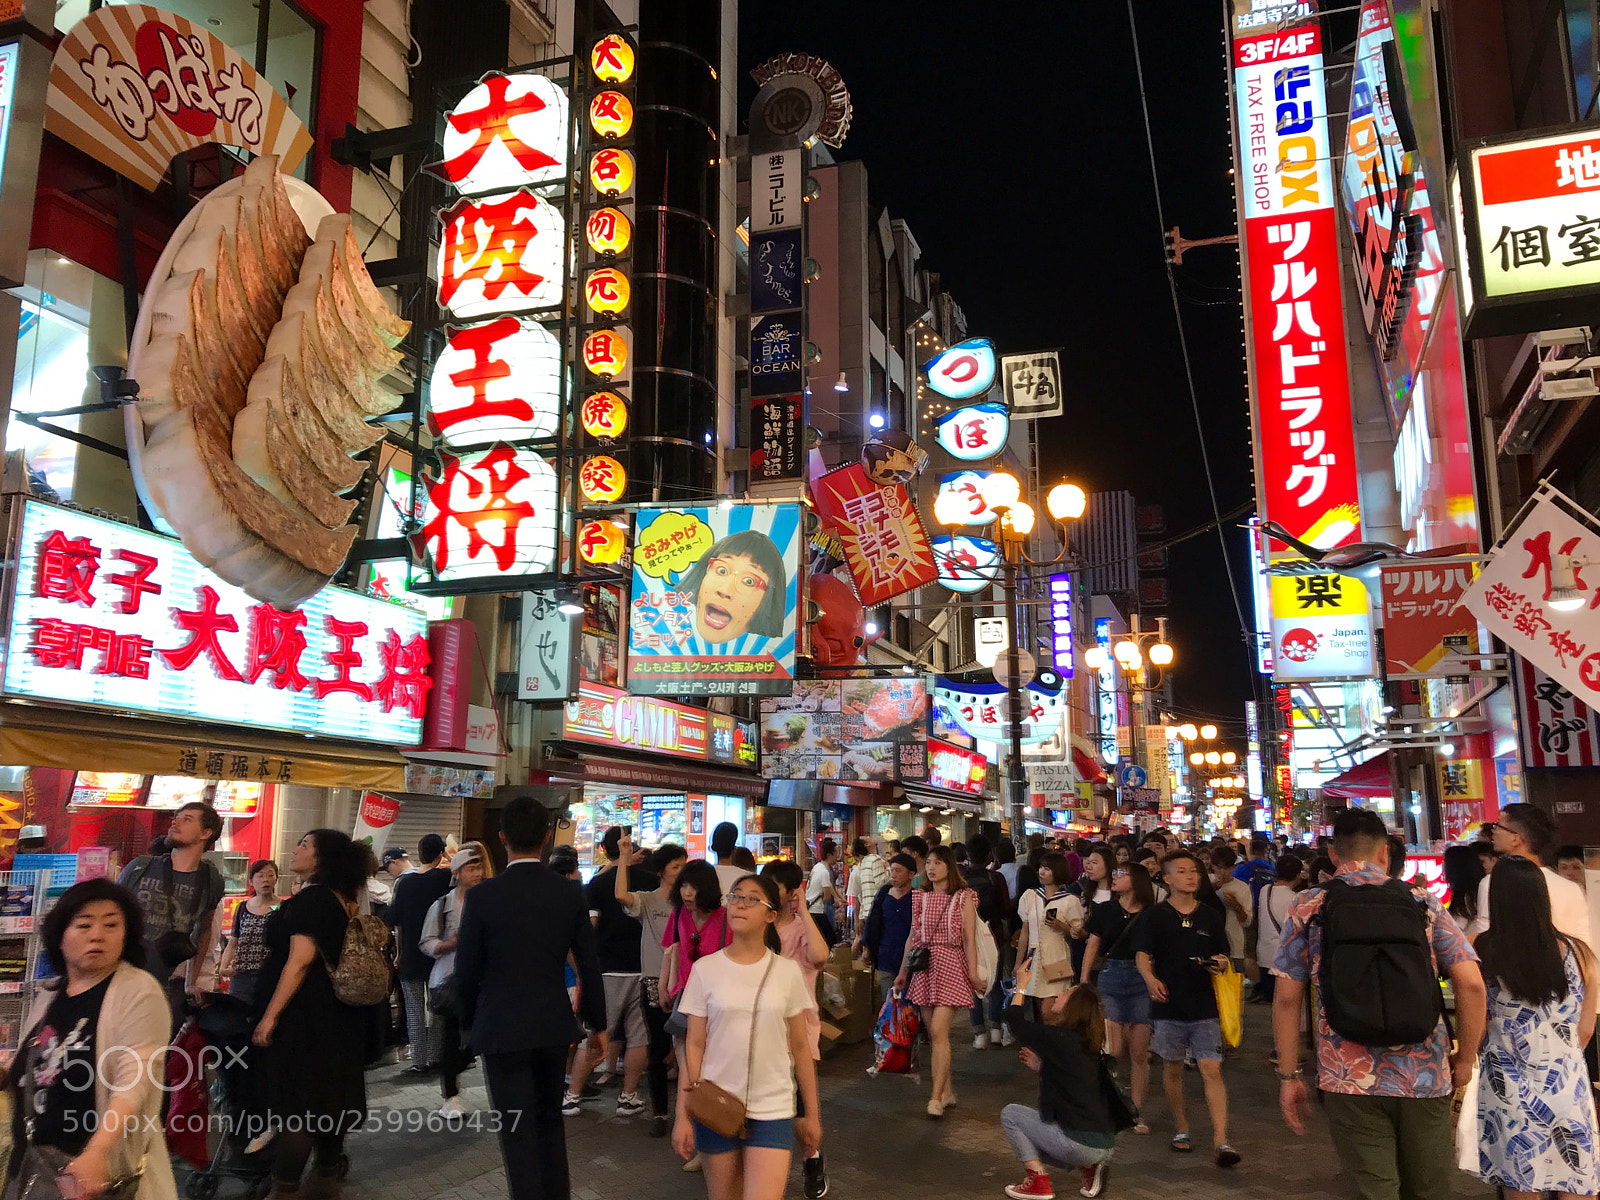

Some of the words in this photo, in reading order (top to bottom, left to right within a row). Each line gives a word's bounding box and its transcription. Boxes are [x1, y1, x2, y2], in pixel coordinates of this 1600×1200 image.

[1239, 32, 1315, 63] 3F/4F
[1247, 75, 1263, 108] TAX
[1250, 113, 1266, 158] FREE
[1555, 145, 1600, 189] 地
[1253, 162, 1270, 211] SHOP
[1491, 214, 1600, 272] 個室
[762, 343, 791, 356] BAR
[752, 360, 801, 375] OCEAN
[1267, 220, 1336, 508] ツルハドラッグ
[1014, 373, 1055, 400] 牛角
[642, 522, 698, 559] おみやげ
[35, 530, 162, 614] 餃子
[1383, 568, 1470, 596] ツルハ
[632, 591, 693, 609] よしもと
[1386, 598, 1457, 618] ドラッグ
[633, 610, 693, 628] エンタメ
[1332, 627, 1367, 639] Japan.
[155, 585, 433, 720] 大阪王将
[632, 629, 693, 649] ショップ
[1329, 638, 1368, 649] Tax-free
[1343, 648, 1369, 660] Shop
[615, 696, 680, 751] GAME
[177, 749, 293, 782] 道頓堀本店
[1033, 766, 1072, 776] PASTA
[1034, 780, 1072, 791] PIZZA
[1441, 764, 1468, 796] 薬
[12, 917, 33, 928] 158
